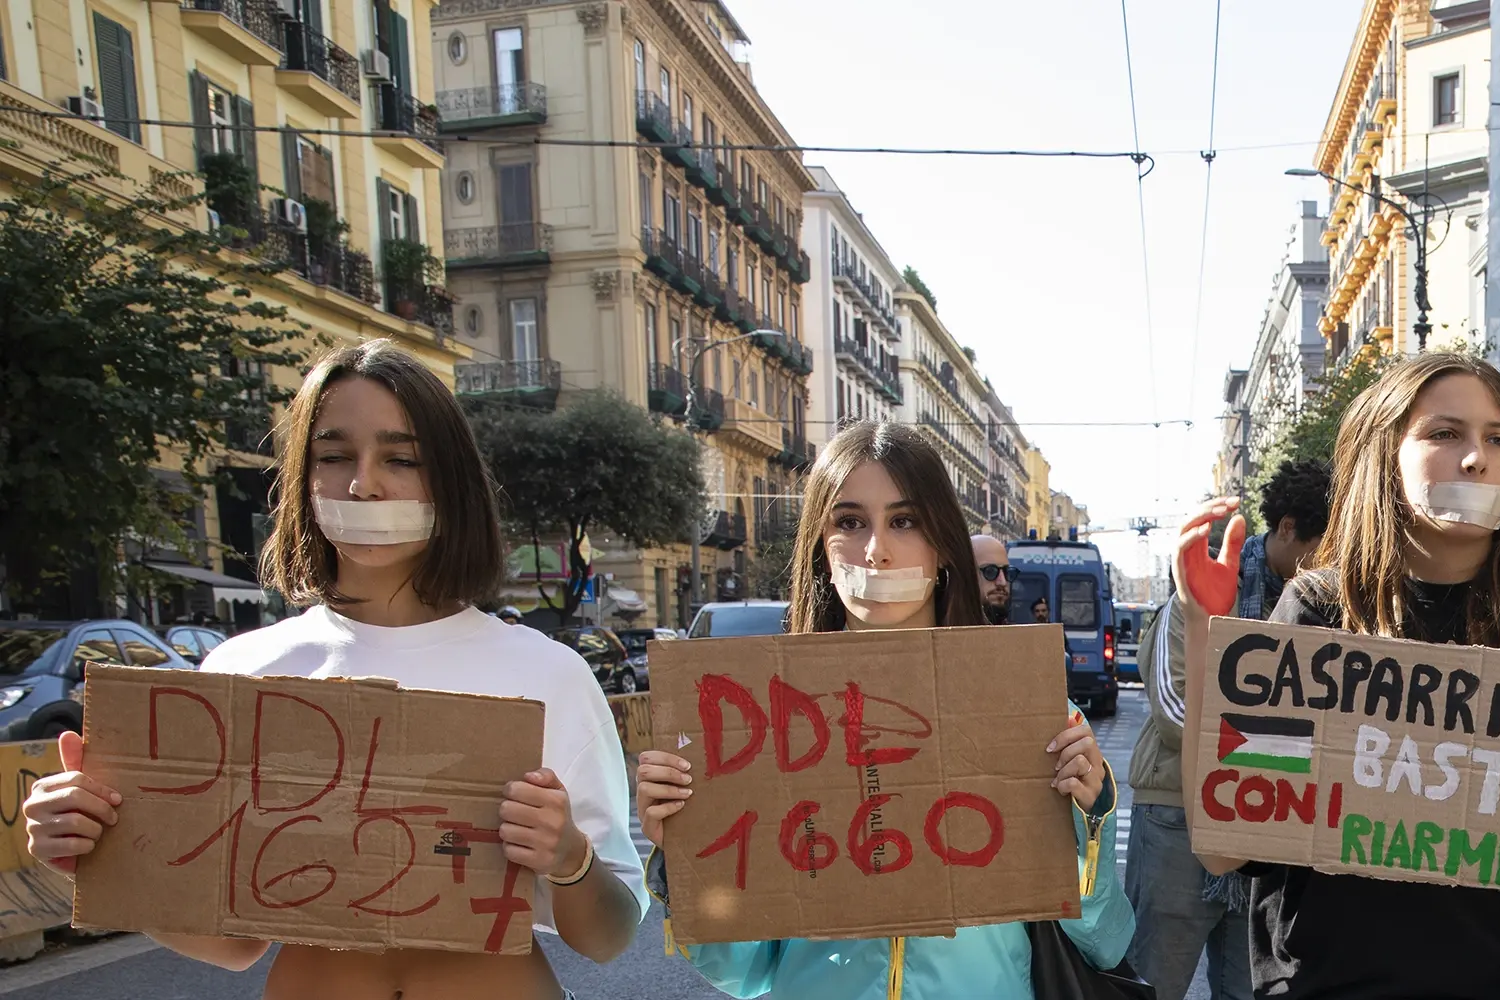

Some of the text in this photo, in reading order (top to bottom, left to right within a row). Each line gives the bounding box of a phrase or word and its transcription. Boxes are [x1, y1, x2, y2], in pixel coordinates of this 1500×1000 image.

[1023, 553, 1085, 566] POLIZIA
[138, 686, 448, 814] DDL
[167, 800, 532, 952] 1627
[696, 791, 1006, 891] 1660
